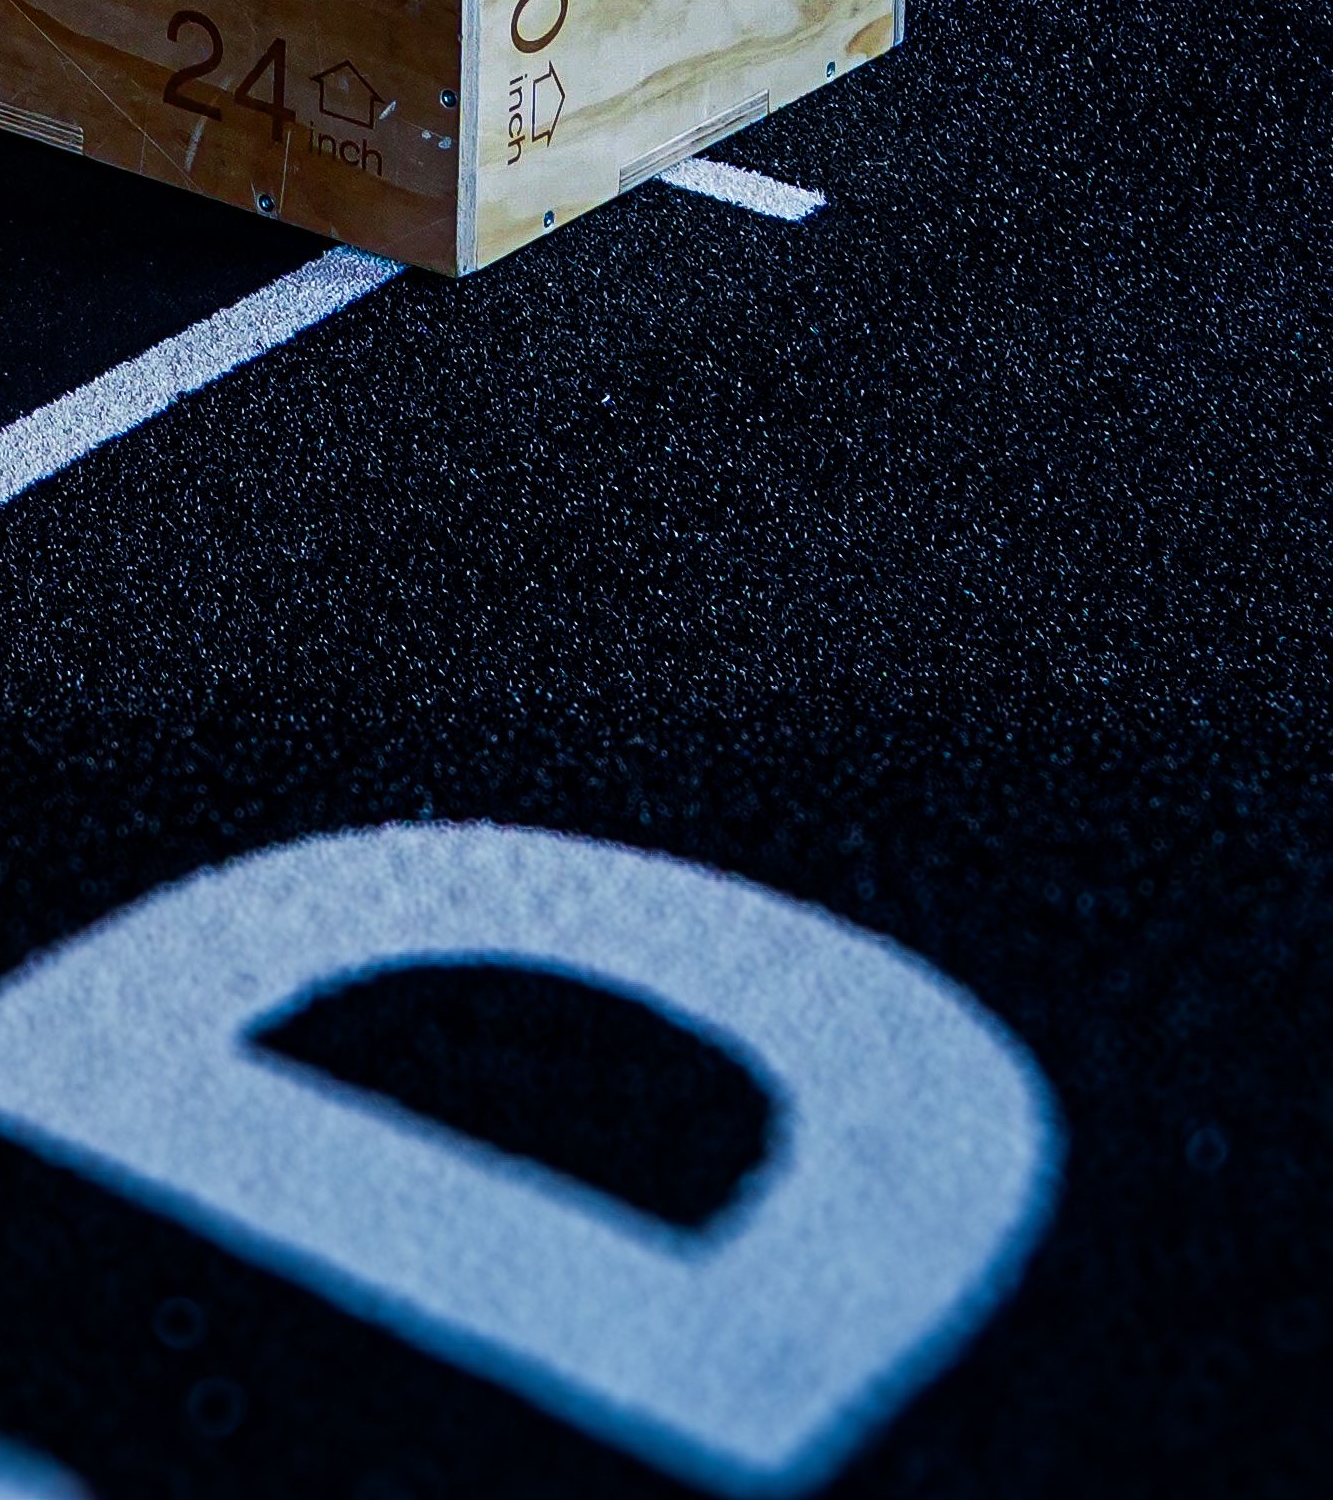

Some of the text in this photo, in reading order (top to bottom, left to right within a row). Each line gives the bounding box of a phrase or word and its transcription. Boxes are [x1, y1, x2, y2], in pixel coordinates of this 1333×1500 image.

[162, 9, 384, 176] 24 inch
[507, 73, 529, 166] inch
